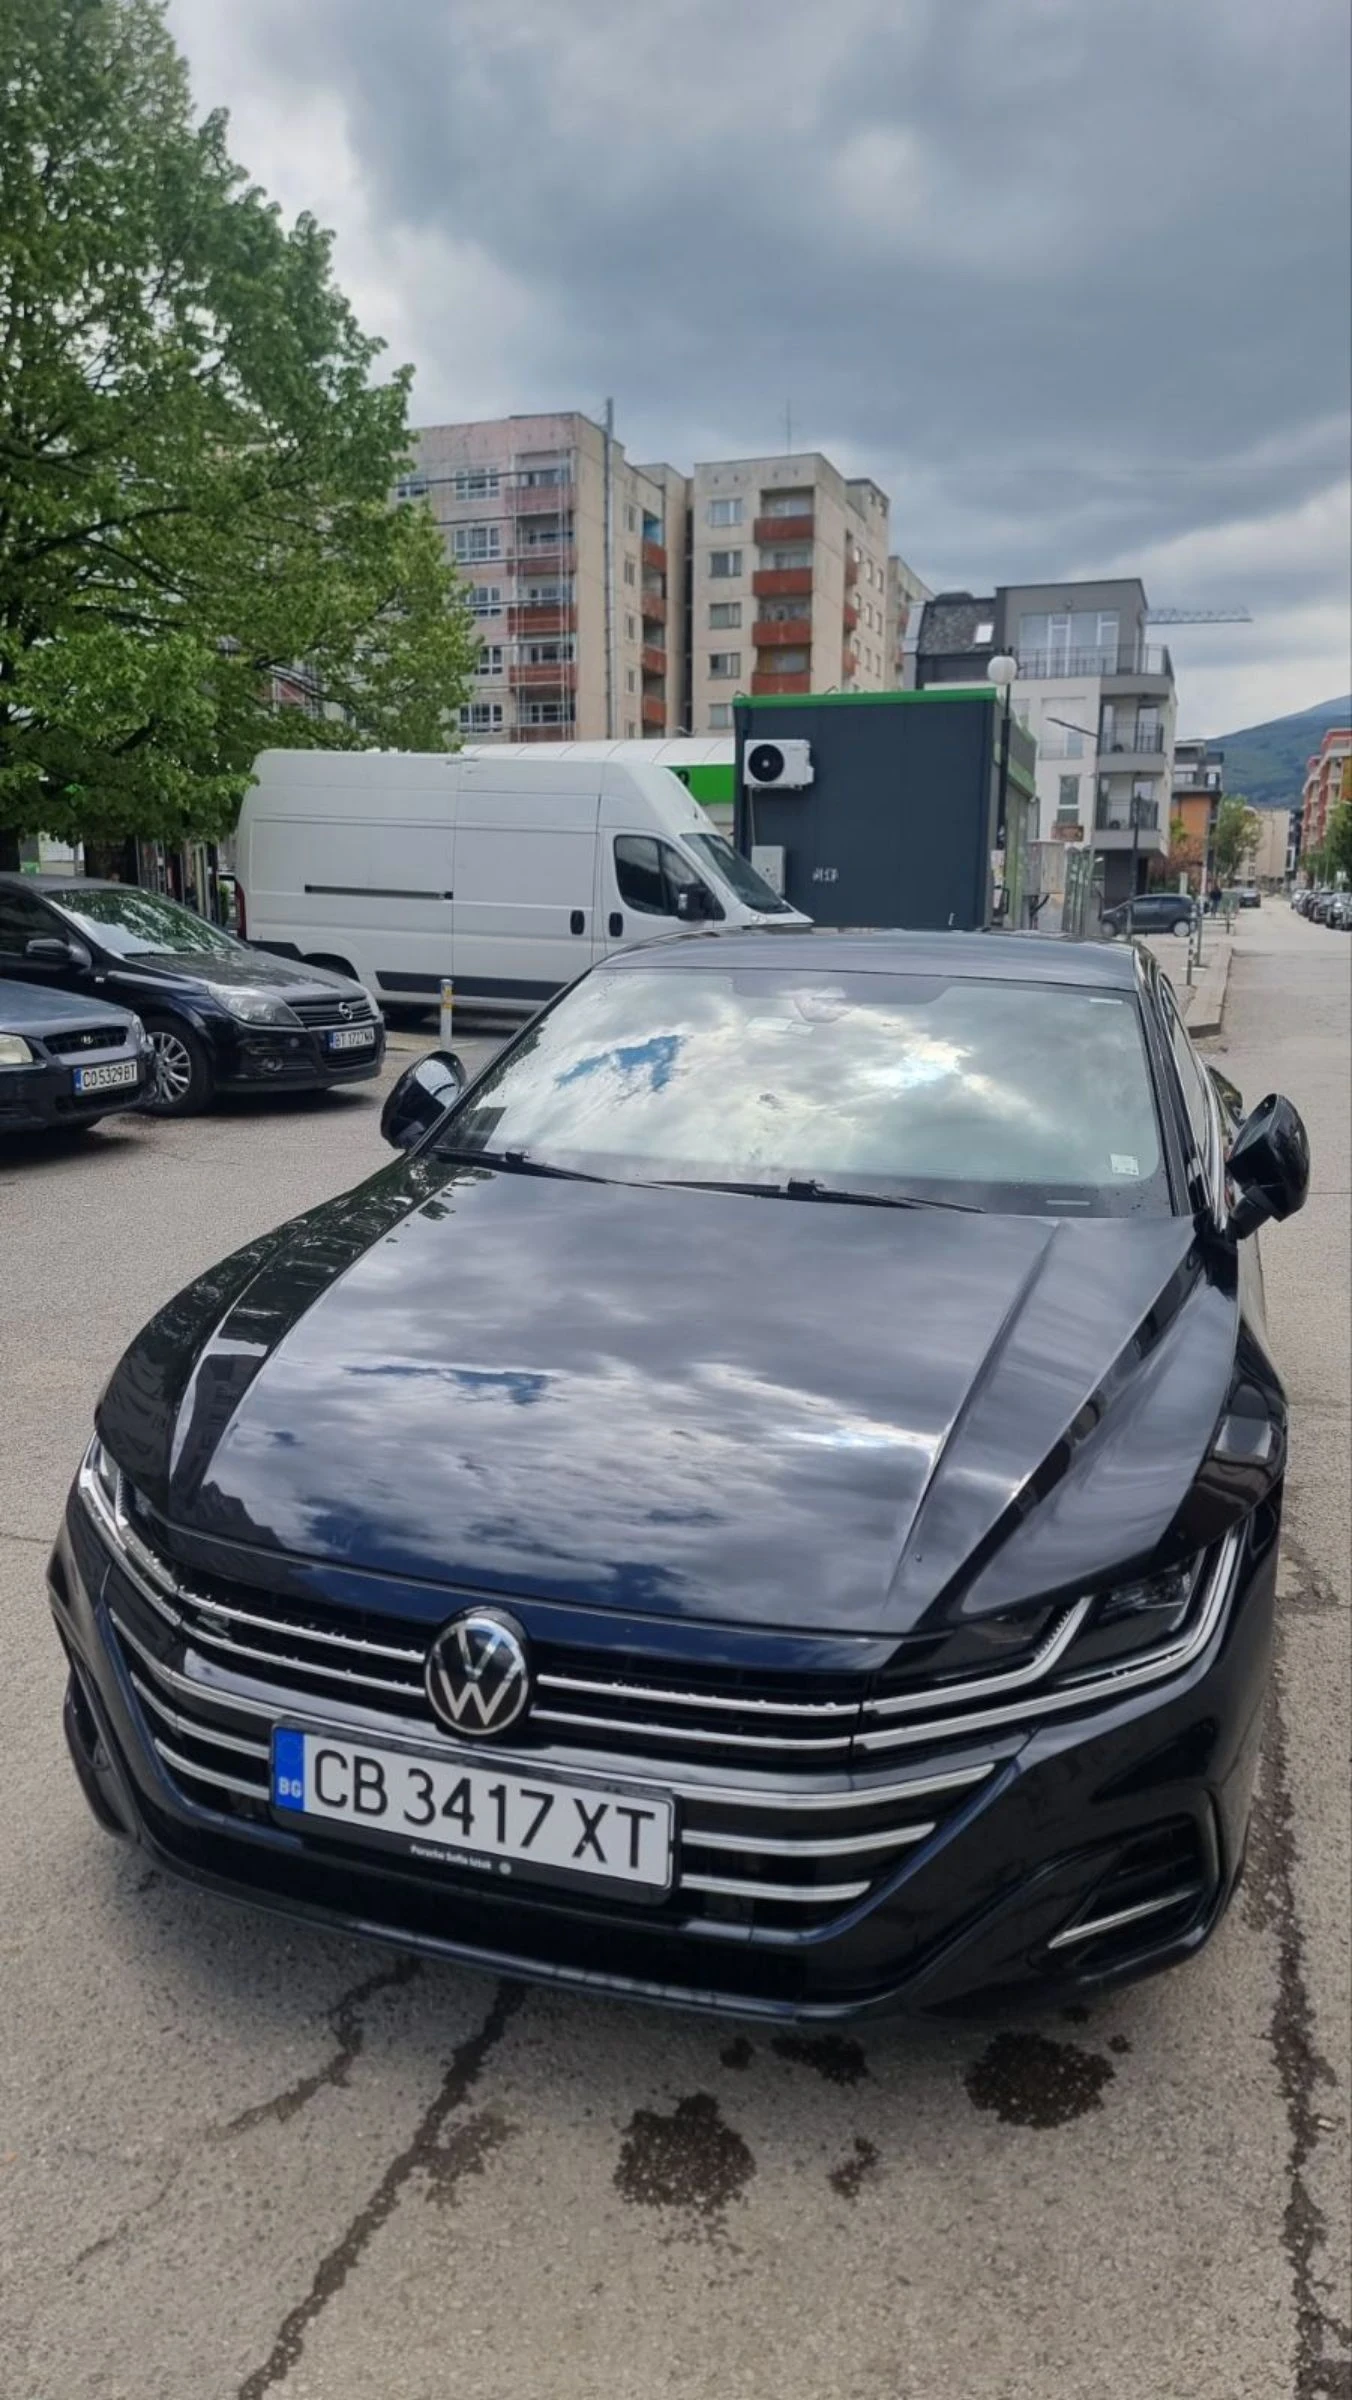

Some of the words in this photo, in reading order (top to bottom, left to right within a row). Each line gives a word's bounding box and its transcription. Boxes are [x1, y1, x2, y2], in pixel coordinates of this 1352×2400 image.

[278, 1776, 302, 1799] BG
[314, 1749, 388, 1817] CB
[403, 1768, 554, 1848] 3417
[572, 1798, 656, 1869] XT
